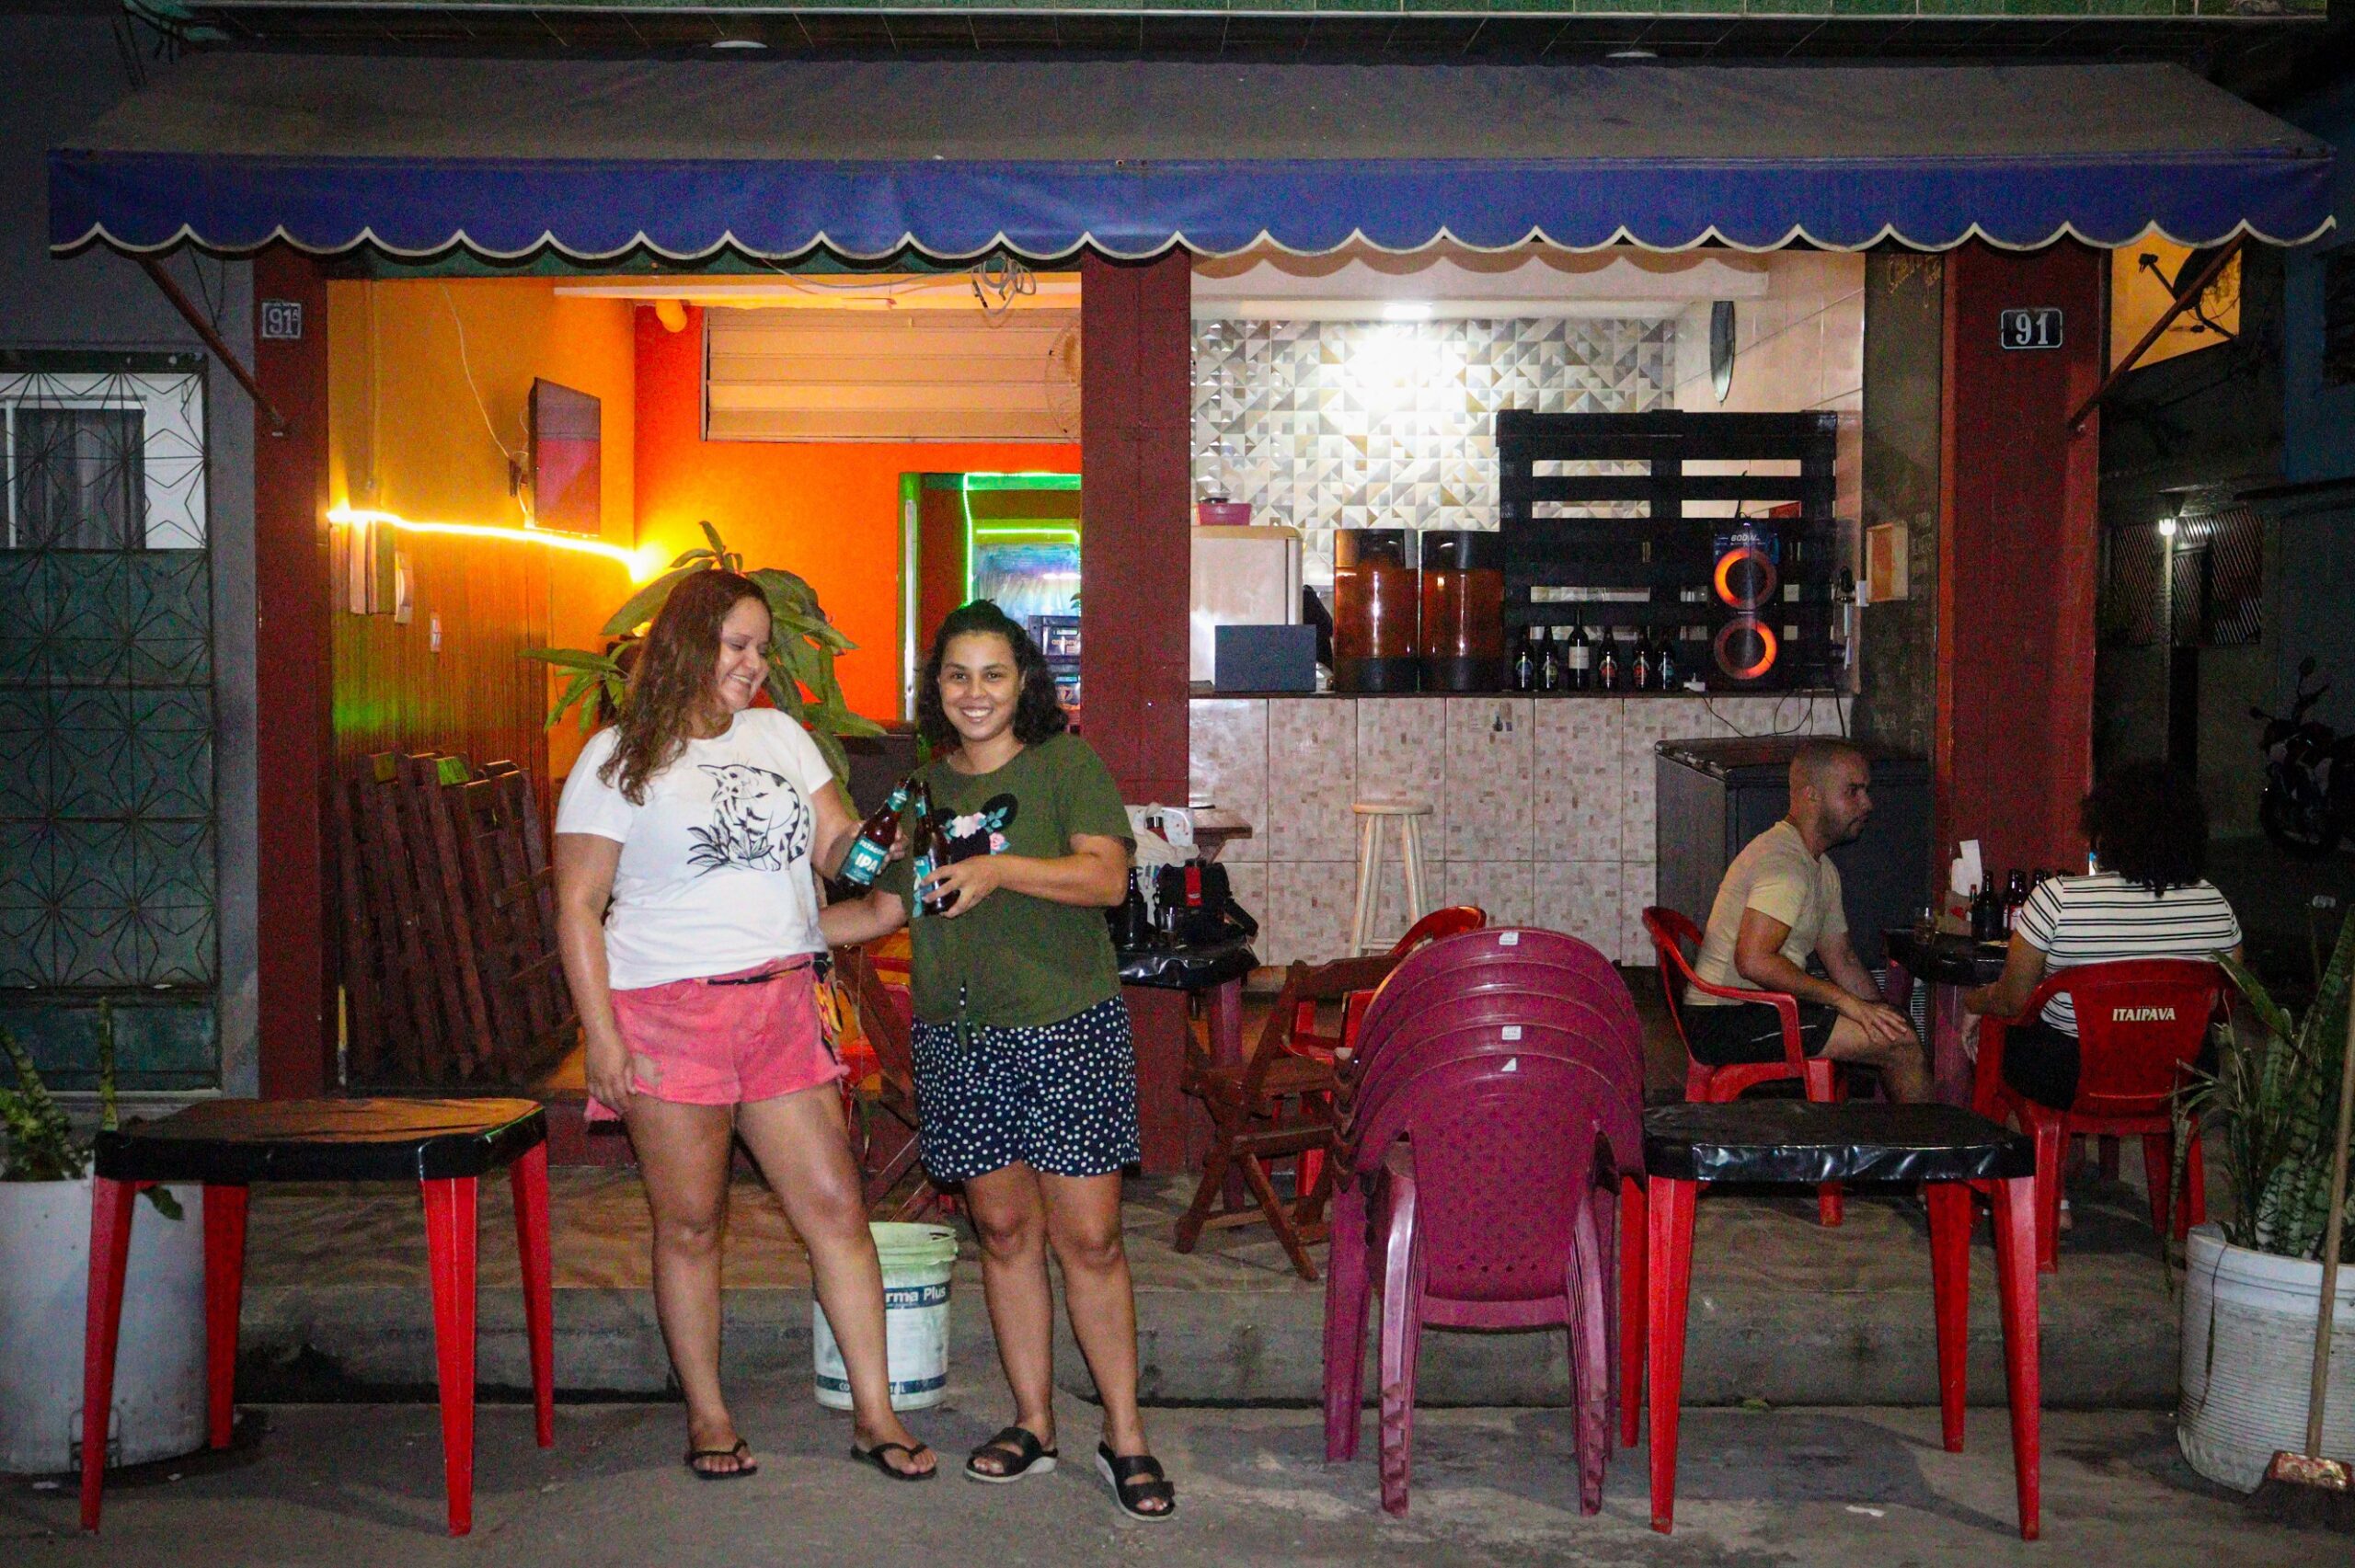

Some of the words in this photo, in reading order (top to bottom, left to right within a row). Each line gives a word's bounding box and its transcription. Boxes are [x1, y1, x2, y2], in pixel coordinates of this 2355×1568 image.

[2016, 313, 2049, 345] 91
[855, 853, 879, 873] IPA
[2112, 1008, 2177, 1022] ITAIPAVA
[885, 1291, 919, 1303] rma
[923, 1286, 946, 1301] Plus
